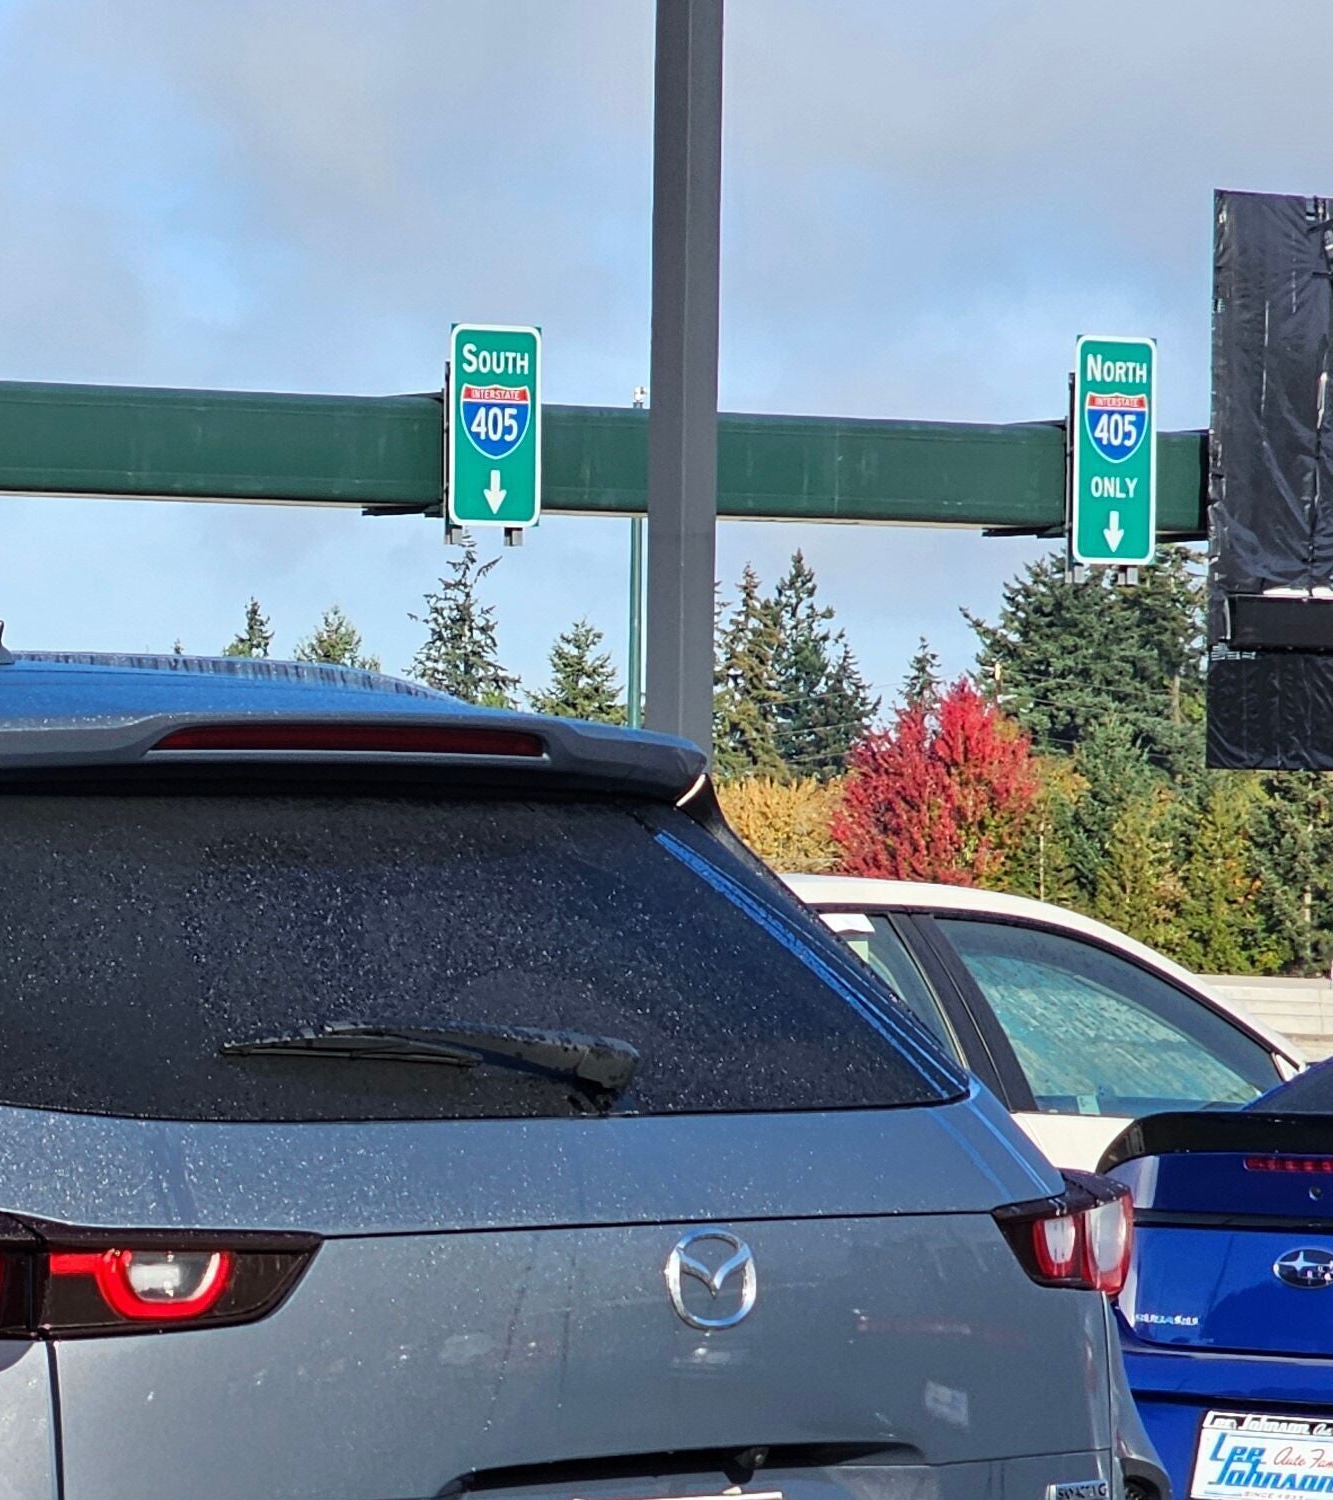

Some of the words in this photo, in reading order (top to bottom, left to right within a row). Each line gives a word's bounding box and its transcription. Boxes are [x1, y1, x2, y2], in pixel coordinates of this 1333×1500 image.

[462, 343, 529, 375] SOUTH
[1086, 353, 1147, 384] NORTH
[471, 389, 520, 400] INTERSTATE
[471, 406, 518, 442] 405
[1094, 413, 1137, 447] 405
[1091, 476, 1138, 498] ONLY
[1209, 1432, 1267, 1465] Lee
